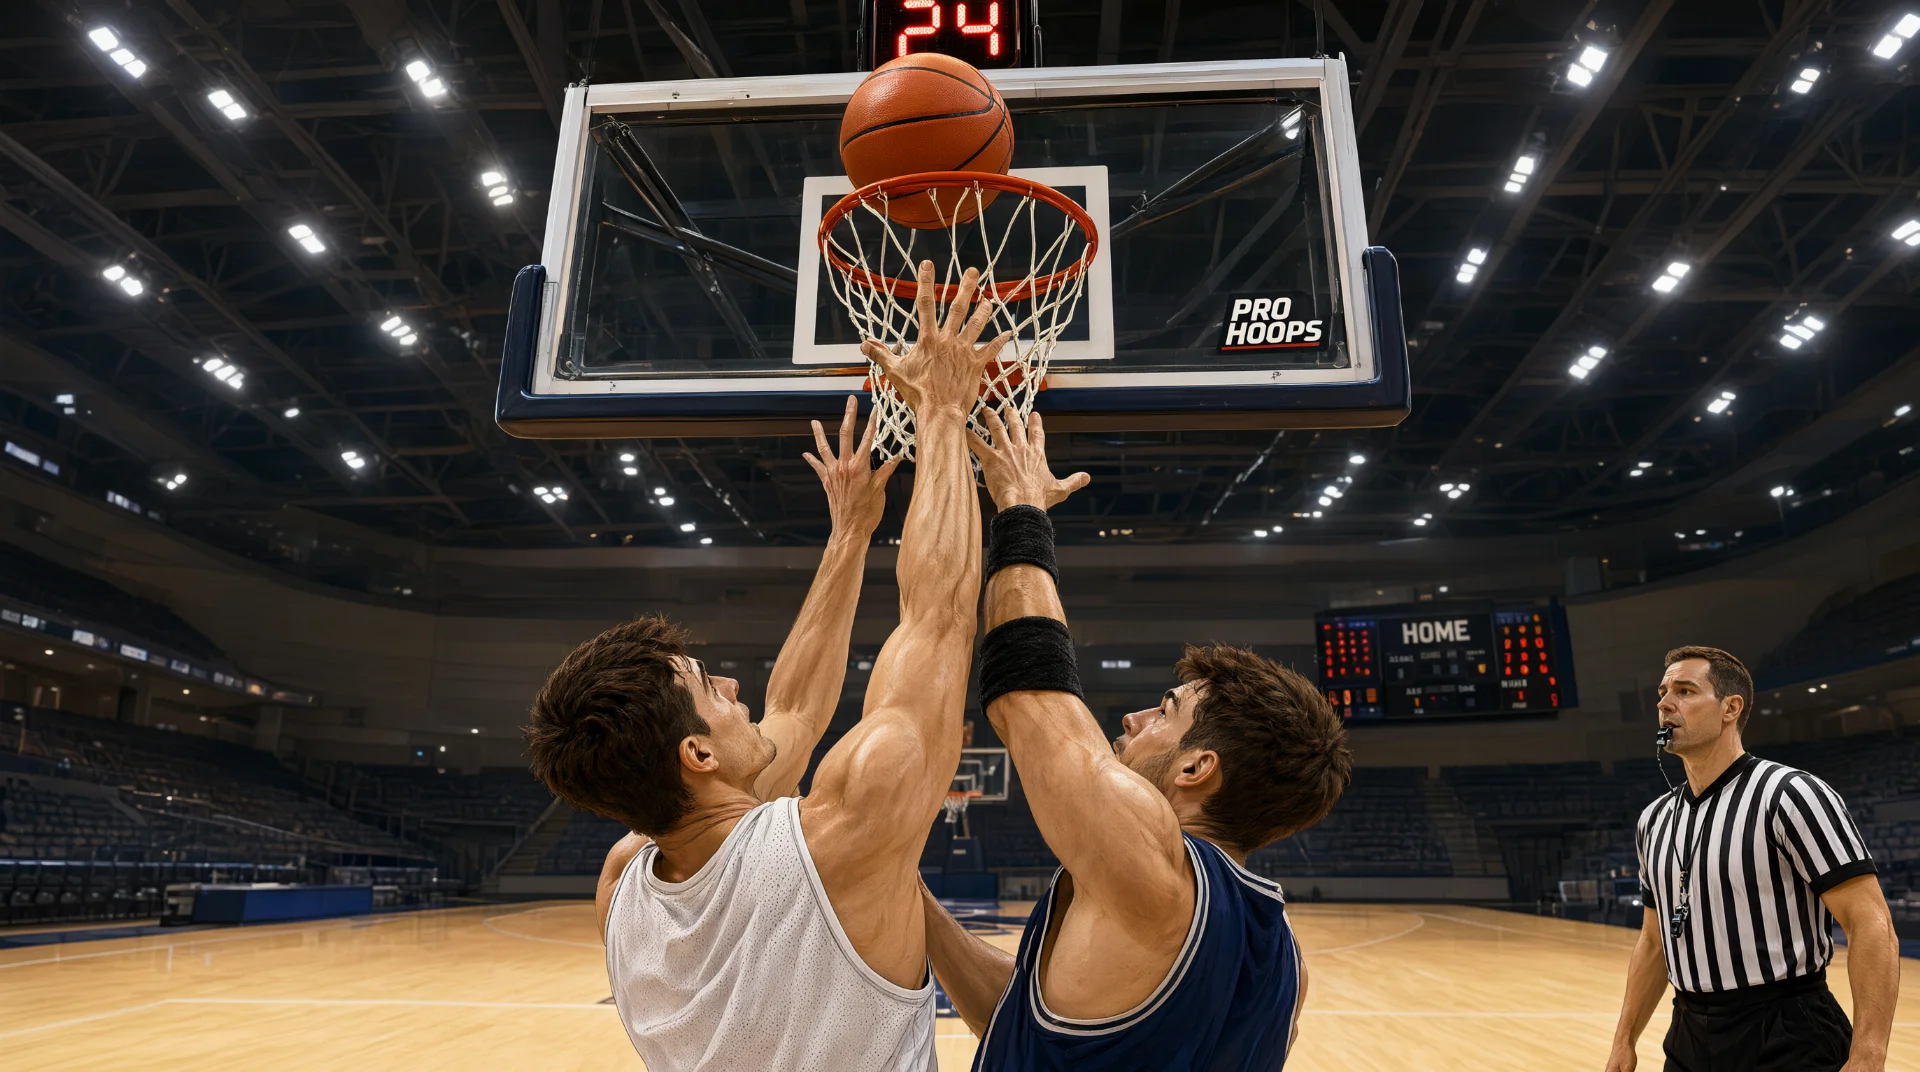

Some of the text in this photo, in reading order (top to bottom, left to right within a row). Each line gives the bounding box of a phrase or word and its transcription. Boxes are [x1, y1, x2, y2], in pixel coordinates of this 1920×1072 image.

[898, 0, 999, 57] 24
[1230, 297, 1292, 322] PRO
[1225, 320, 1323, 346] HOOPS
[1401, 619, 1471, 645] HOME
